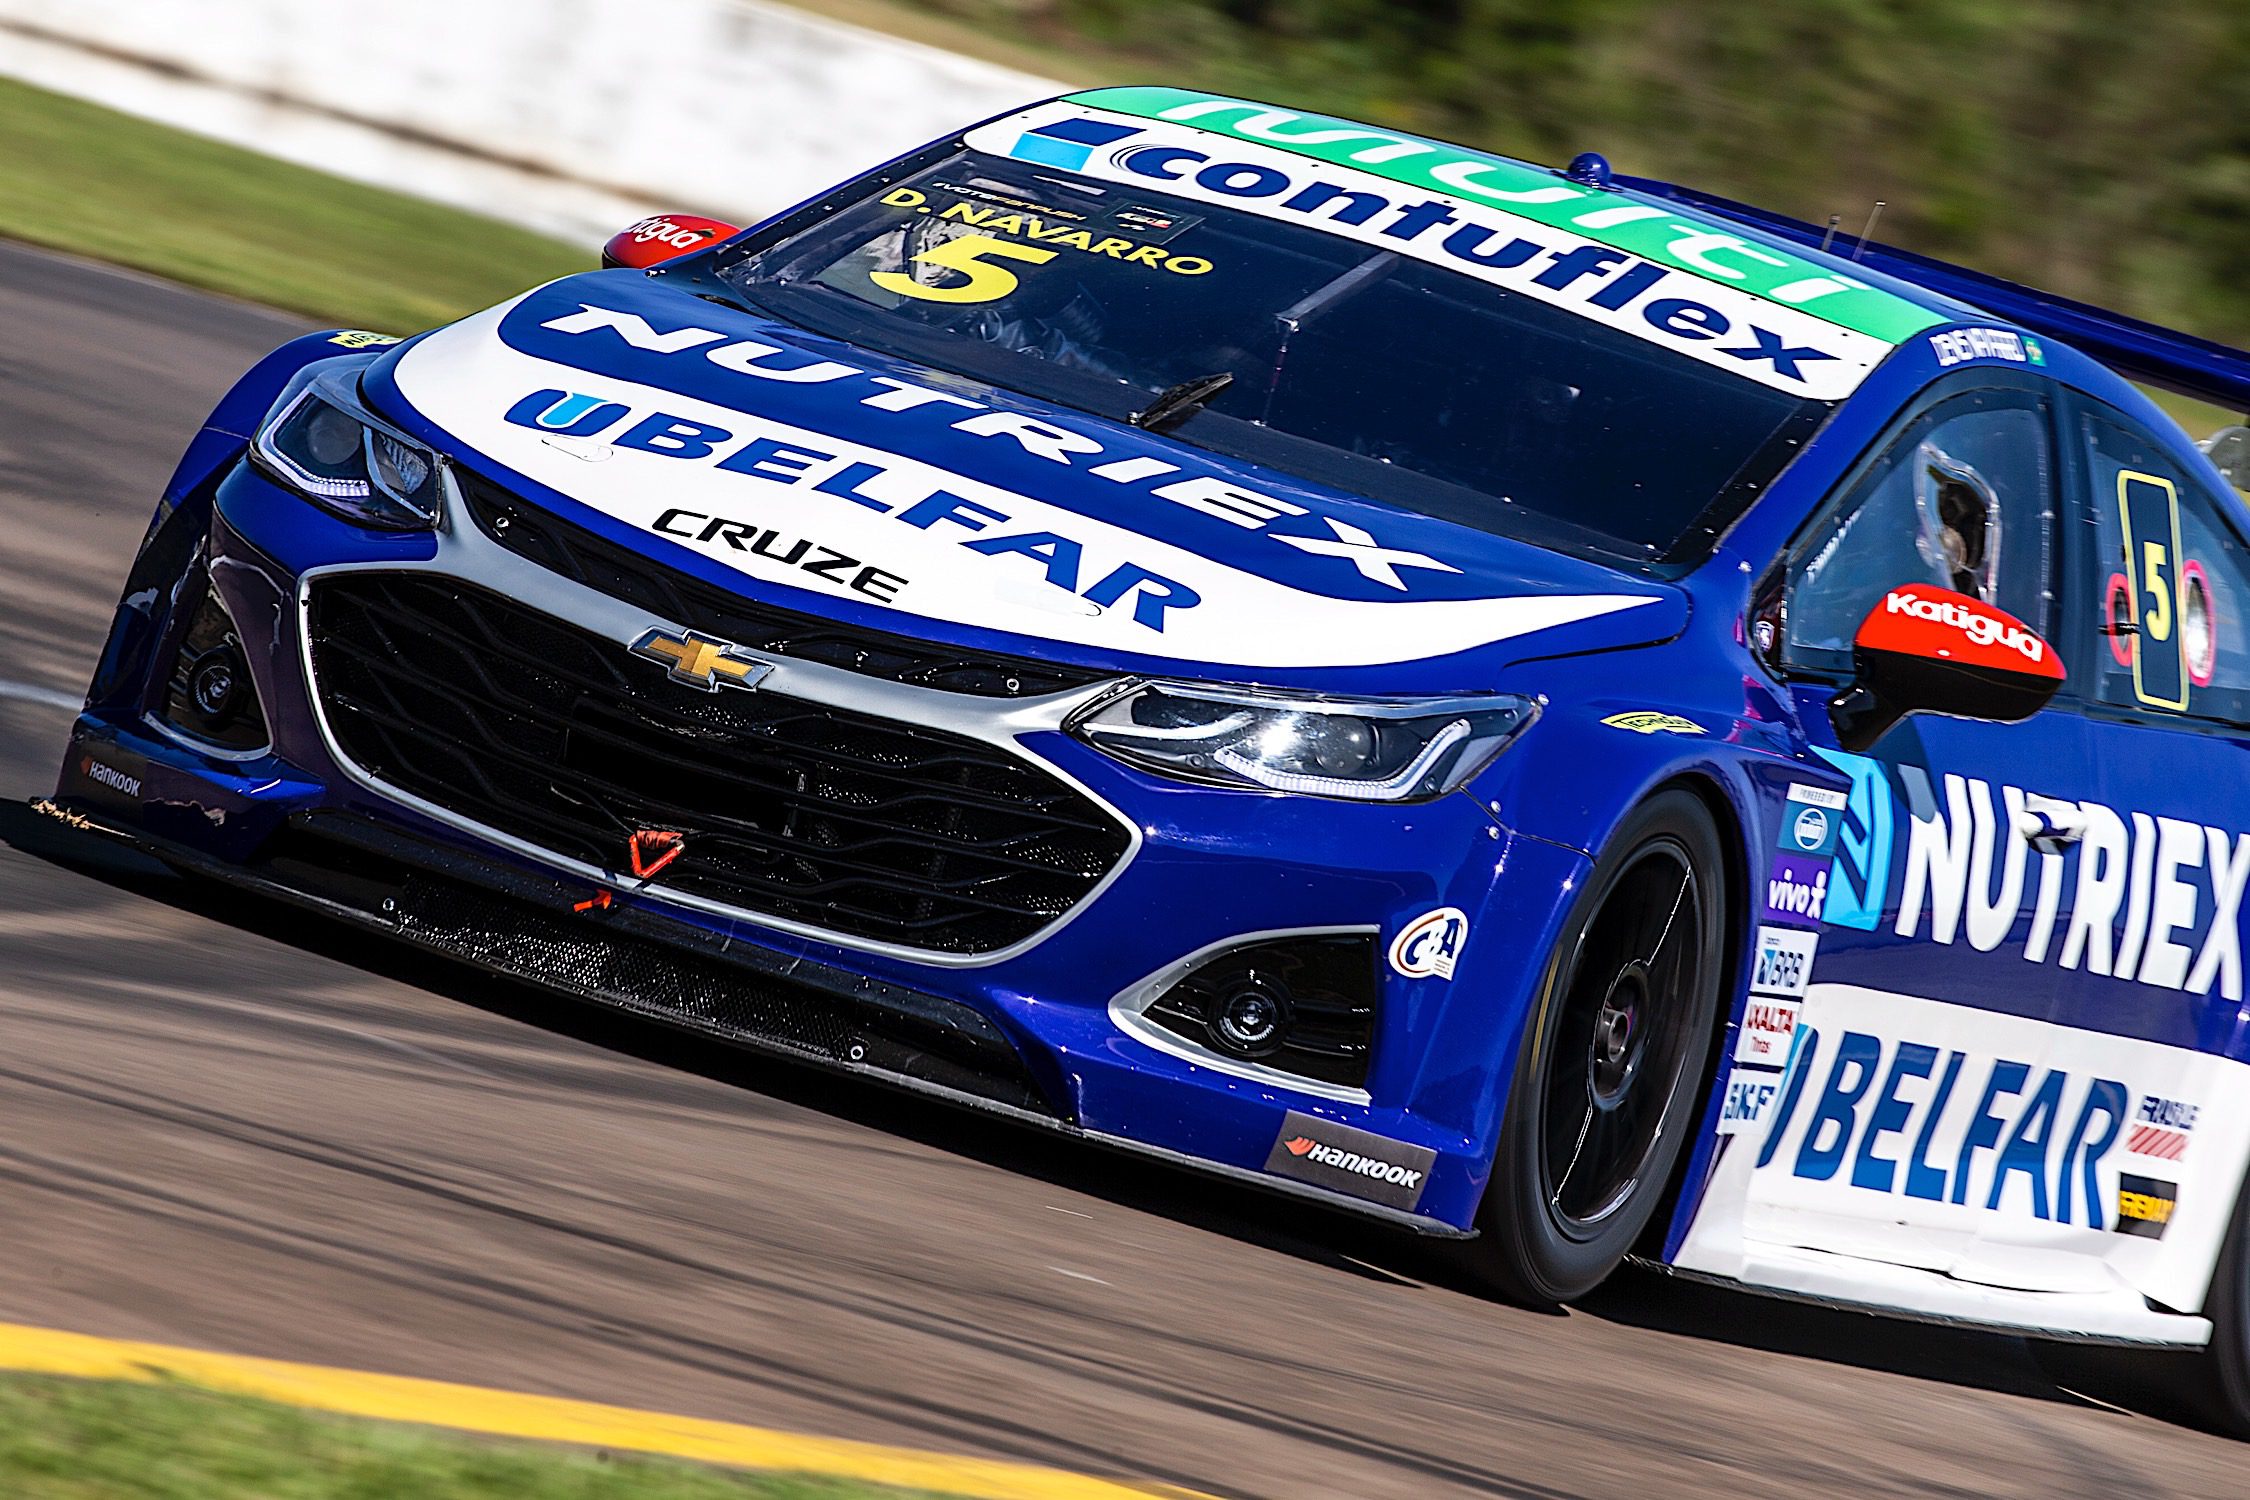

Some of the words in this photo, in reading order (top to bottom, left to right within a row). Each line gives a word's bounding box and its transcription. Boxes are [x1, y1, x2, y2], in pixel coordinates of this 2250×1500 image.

[869, 233, 1060, 303] 5
[879, 187, 931, 214] D.
[940, 200, 1214, 275] NAVARRO
[1110, 143, 1843, 384] contuflex
[540, 302, 1463, 592] NUTRIEX
[651, 507, 910, 605] CRUZE
[2143, 541, 2171, 642] 5
[1887, 592, 2044, 663] Katigua
[1768, 868, 1810, 914] vivo
[1894, 773, 2250, 1002] NUTRIEX
